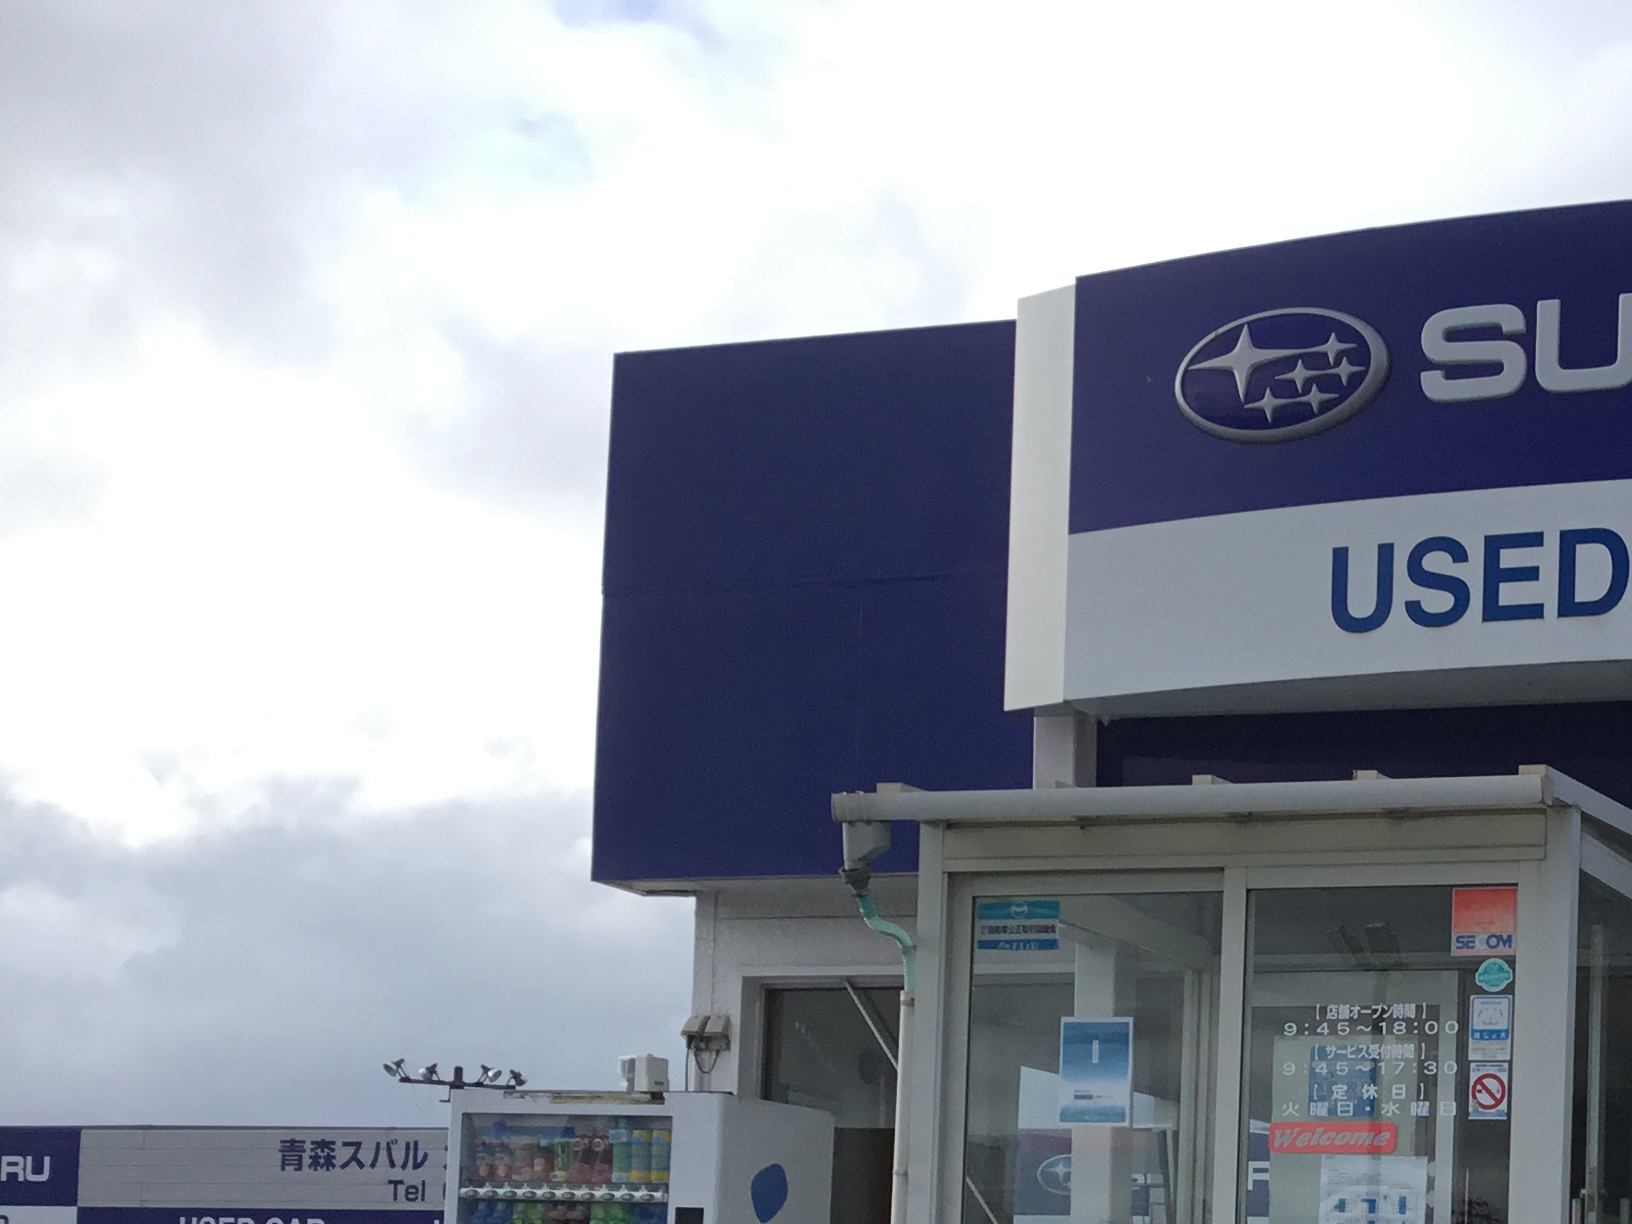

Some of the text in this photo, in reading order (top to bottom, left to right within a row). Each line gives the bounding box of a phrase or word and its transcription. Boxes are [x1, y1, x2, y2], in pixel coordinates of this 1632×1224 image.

[1331, 527, 1630, 634] USED
[1455, 934, 1513, 950] SECOM
[1272, 1126, 1392, 1149] Welcome
[278, 1138, 429, 1172] 青森スバル
[387, 1179, 426, 1202] Tel
